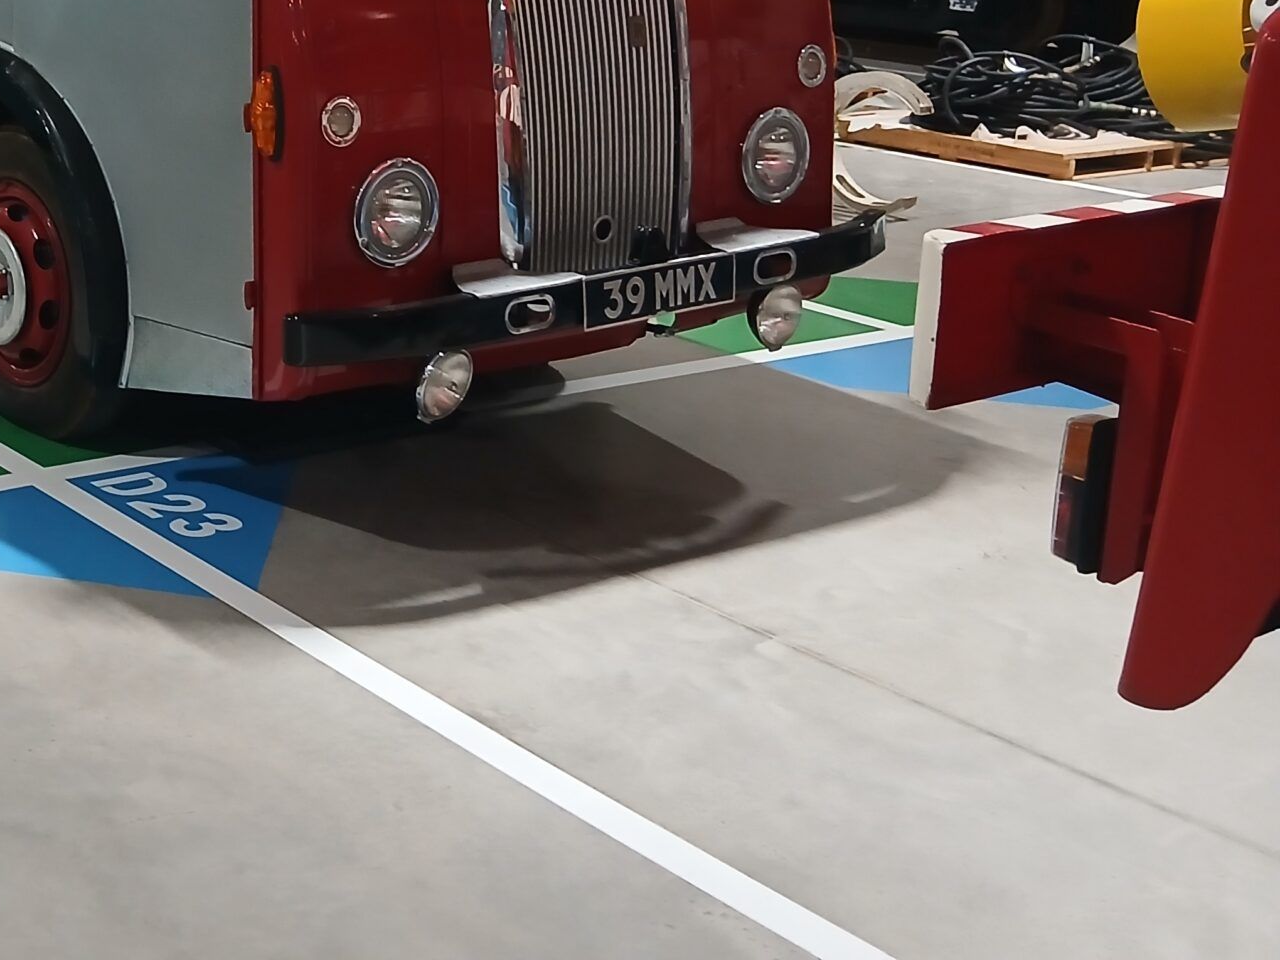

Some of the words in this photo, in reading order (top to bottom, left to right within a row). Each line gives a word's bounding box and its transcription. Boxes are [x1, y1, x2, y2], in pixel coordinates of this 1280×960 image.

[603, 275, 645, 319] 39
[654, 261, 717, 310] MMX
[90, 471, 243, 537] D23
